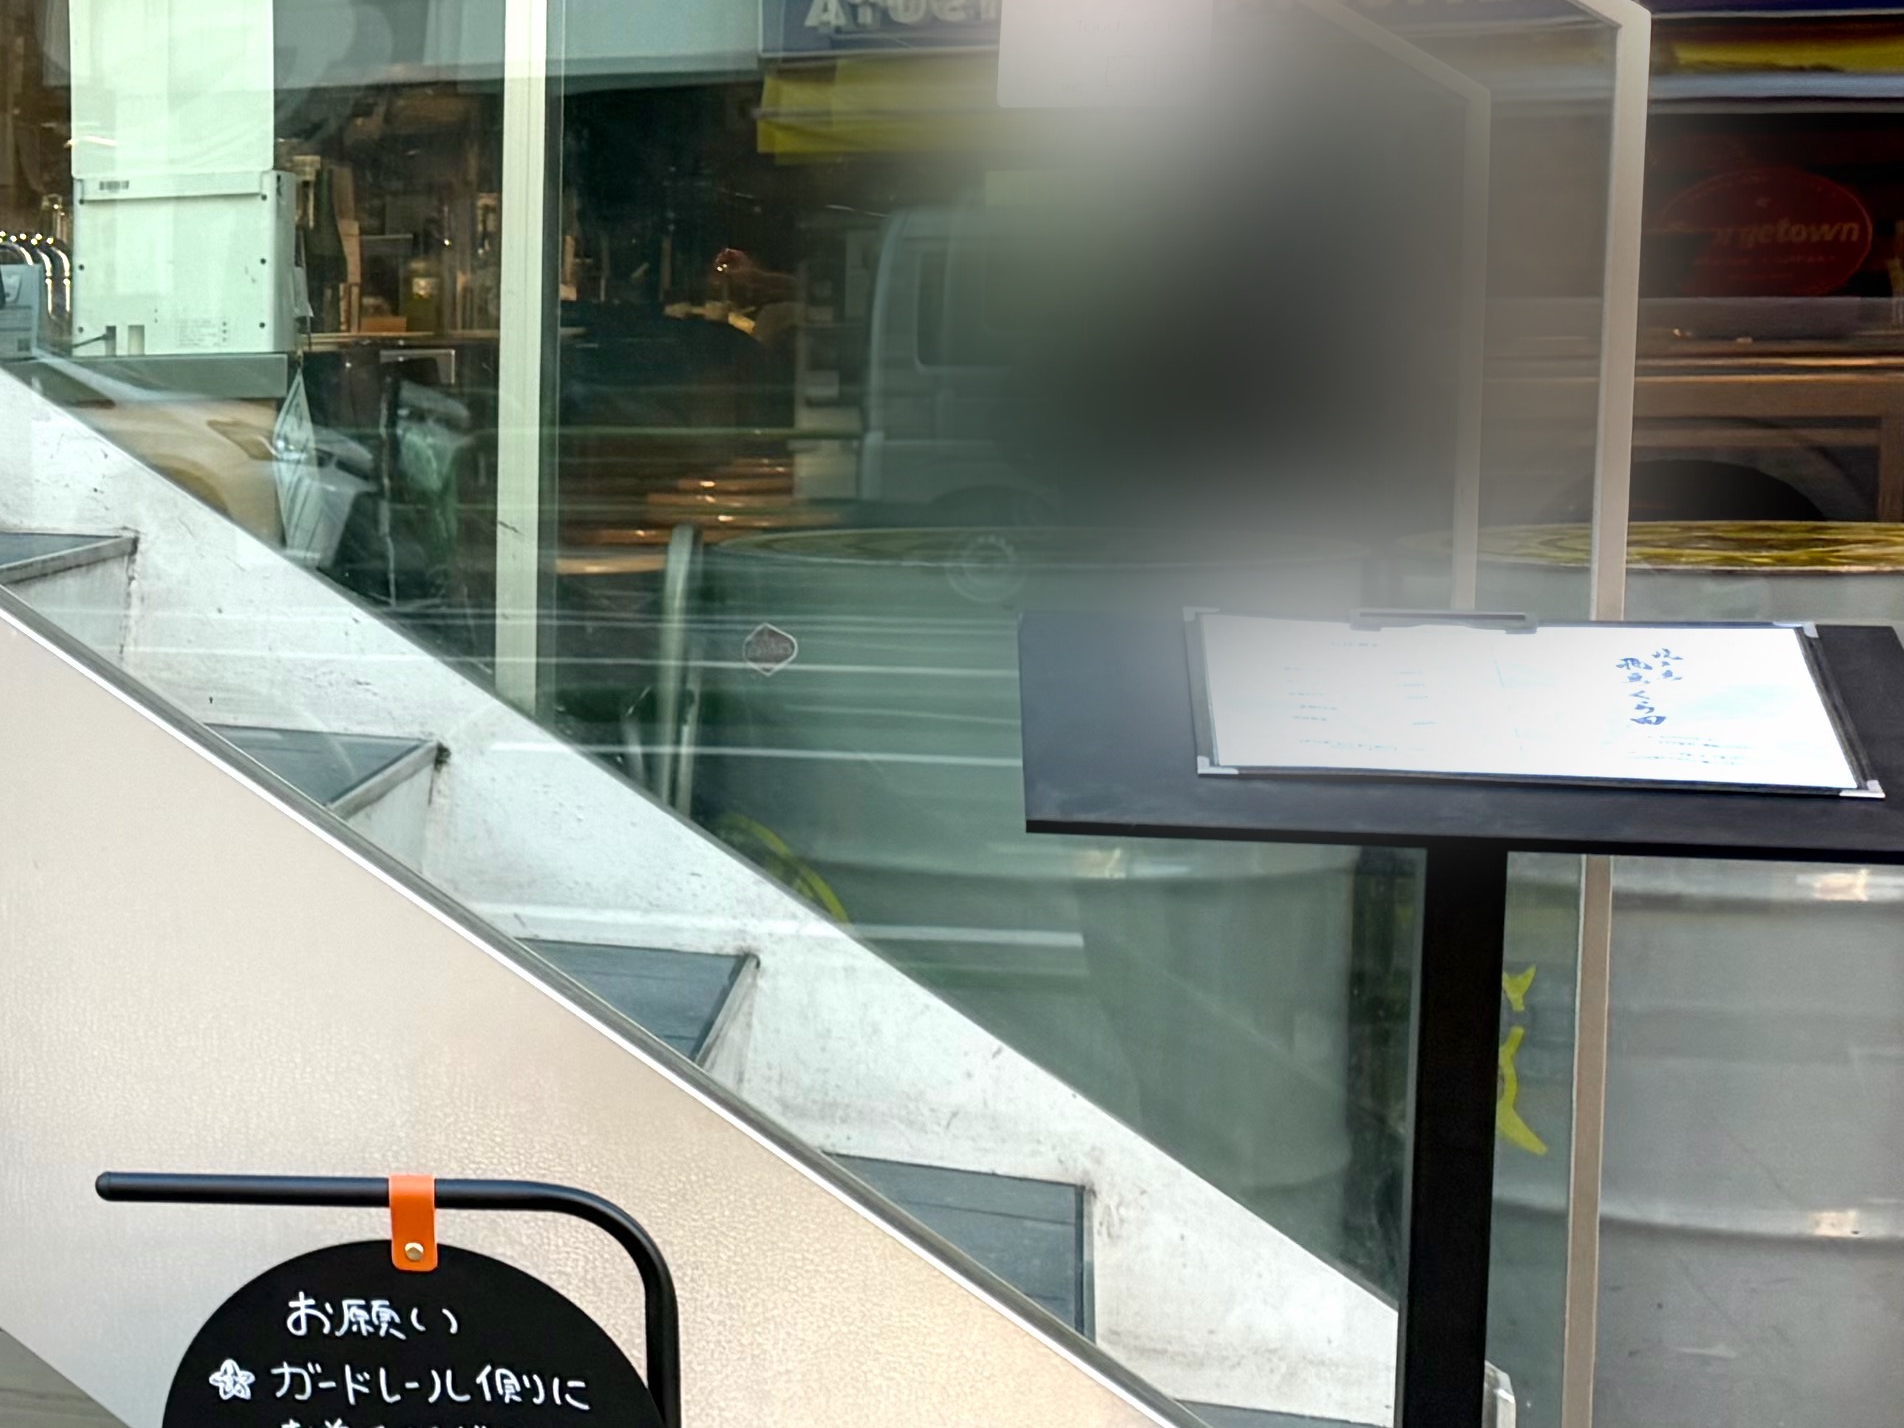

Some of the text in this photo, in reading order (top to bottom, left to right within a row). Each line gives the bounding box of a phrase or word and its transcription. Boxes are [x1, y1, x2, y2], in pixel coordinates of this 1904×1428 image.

[286, 1291, 460, 1340] お願い
[271, 1362, 591, 1411] ガードレール側に
